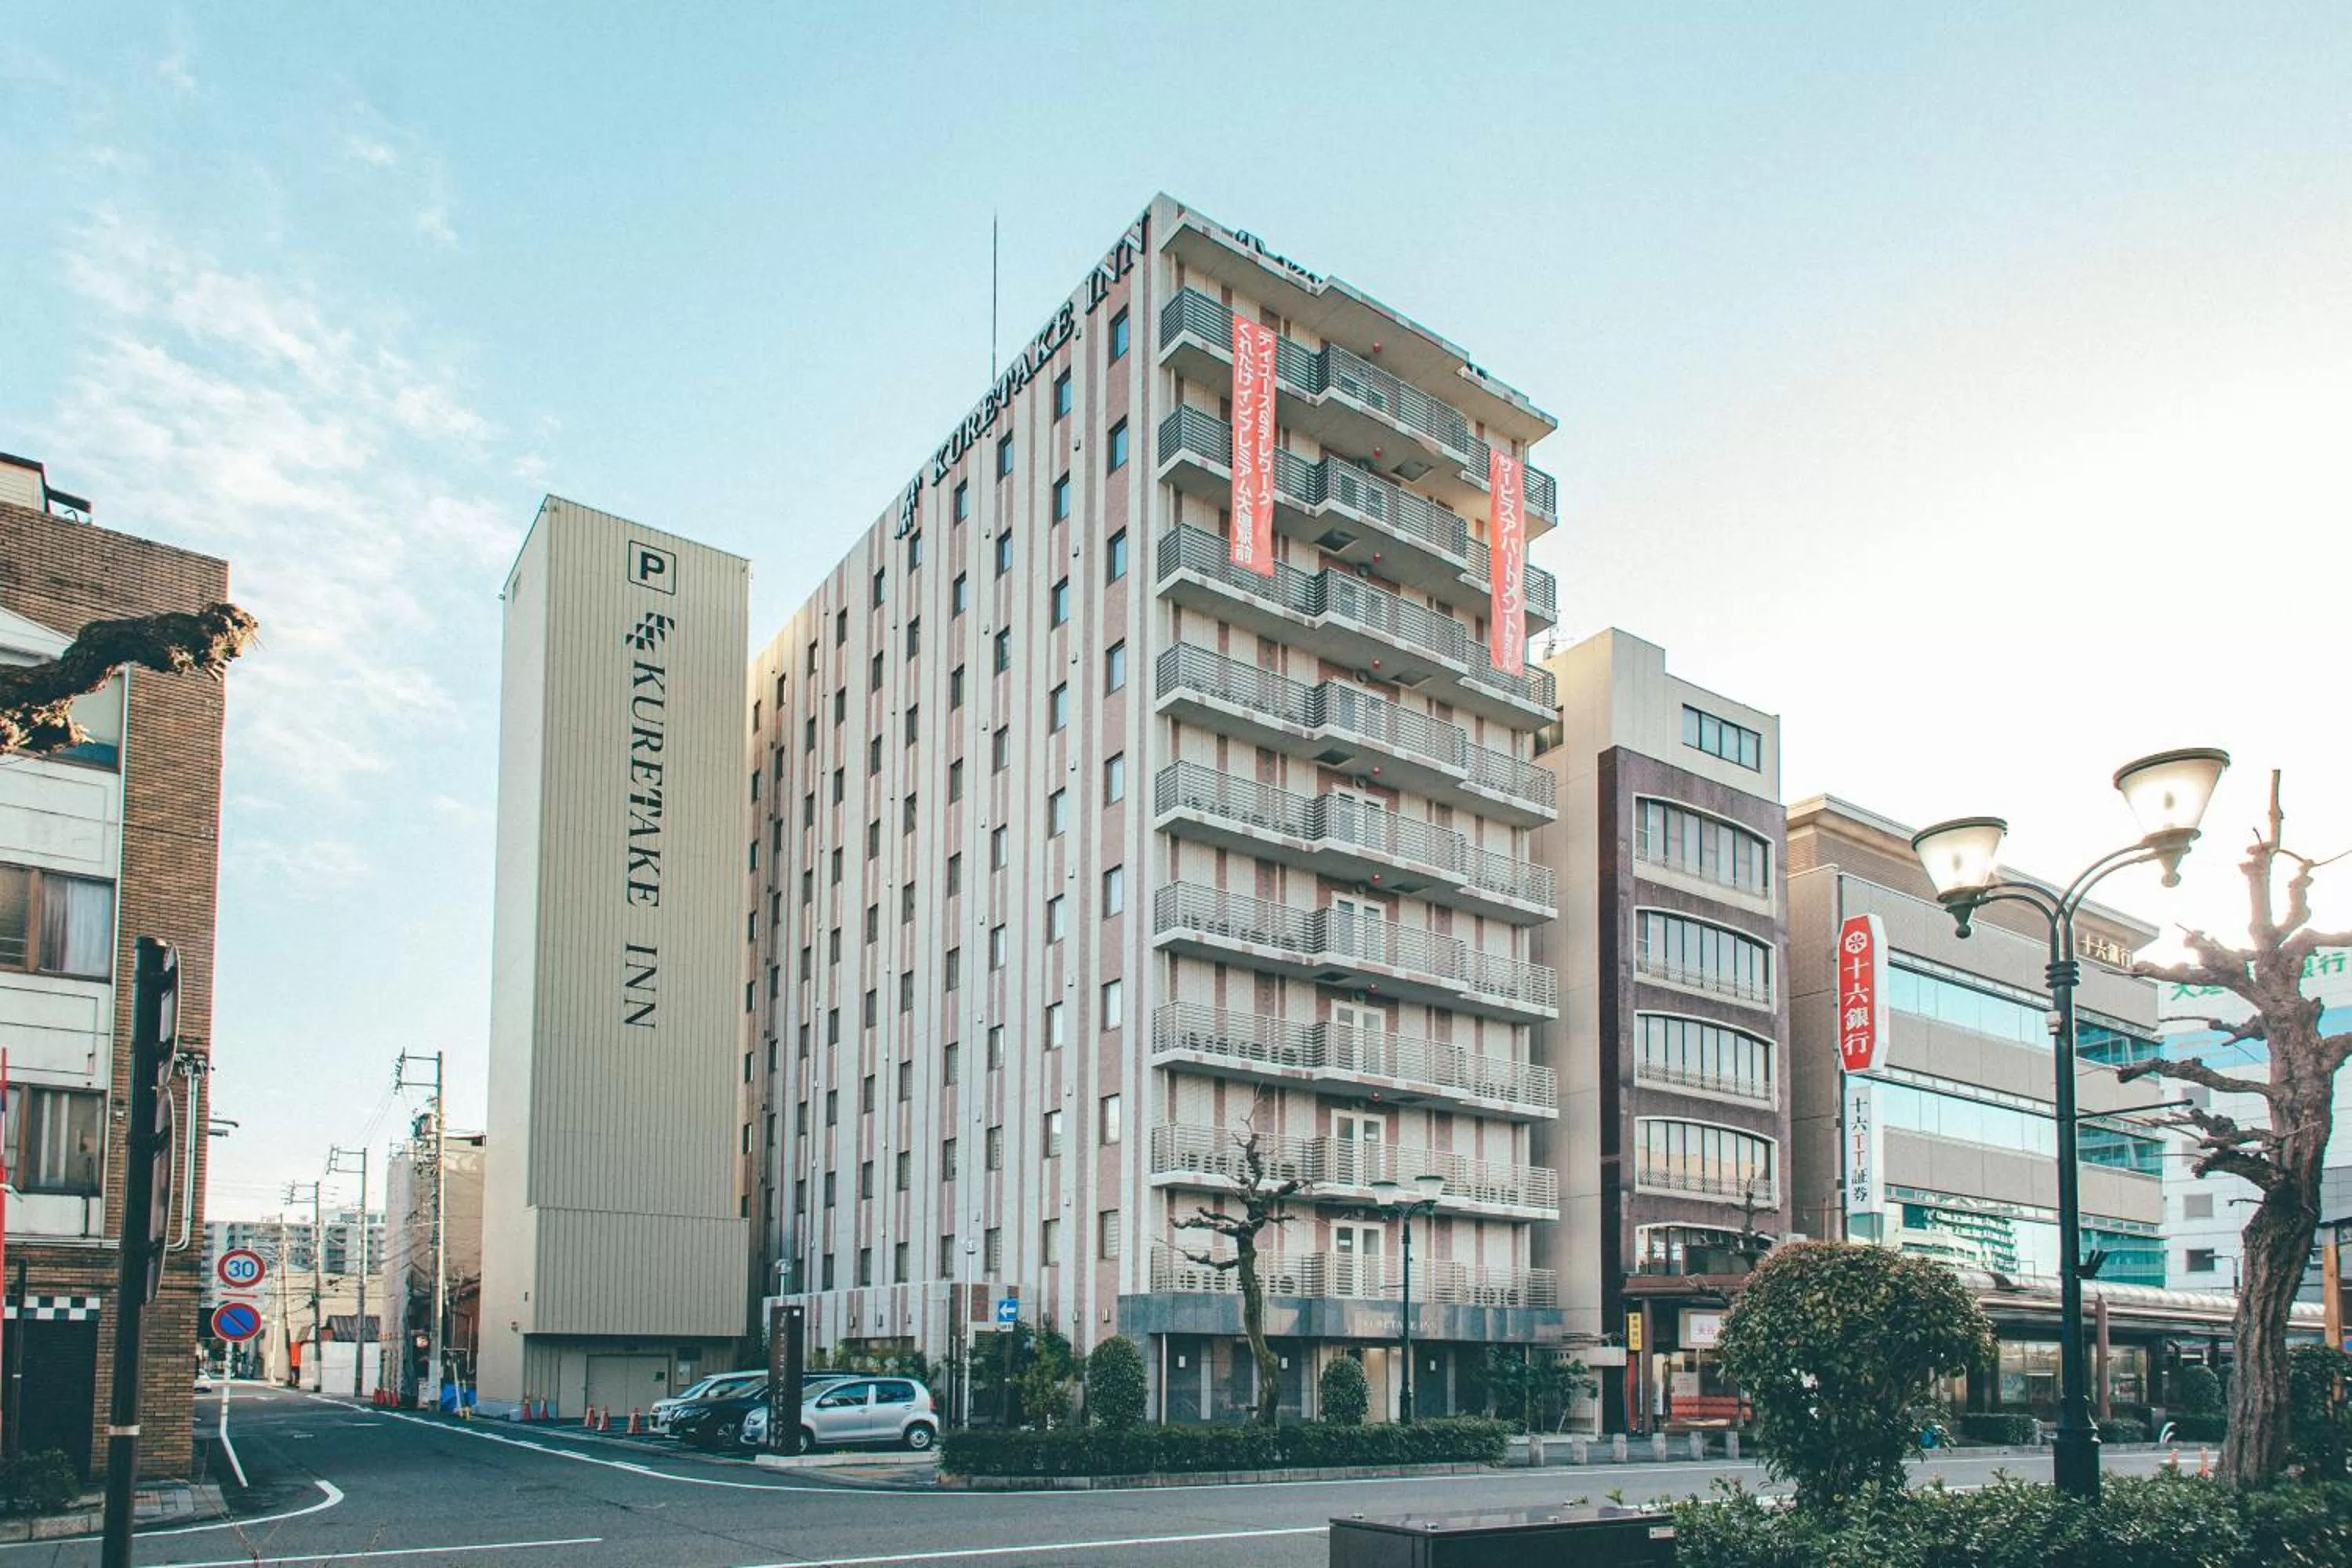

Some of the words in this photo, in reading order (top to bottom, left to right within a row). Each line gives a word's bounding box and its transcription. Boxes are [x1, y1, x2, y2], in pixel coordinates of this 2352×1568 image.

[931, 300, 1075, 487] KURETAKE
[1085, 210, 1151, 315] INN
[641, 551, 666, 580] P
[627, 661, 666, 907] KURETAKE
[624, 940, 658, 1029] INN
[2080, 933, 2131, 967] 十六銀行
[1844, 957, 1869, 1055] 十六銀行
[228, 1260, 255, 1277] 30
